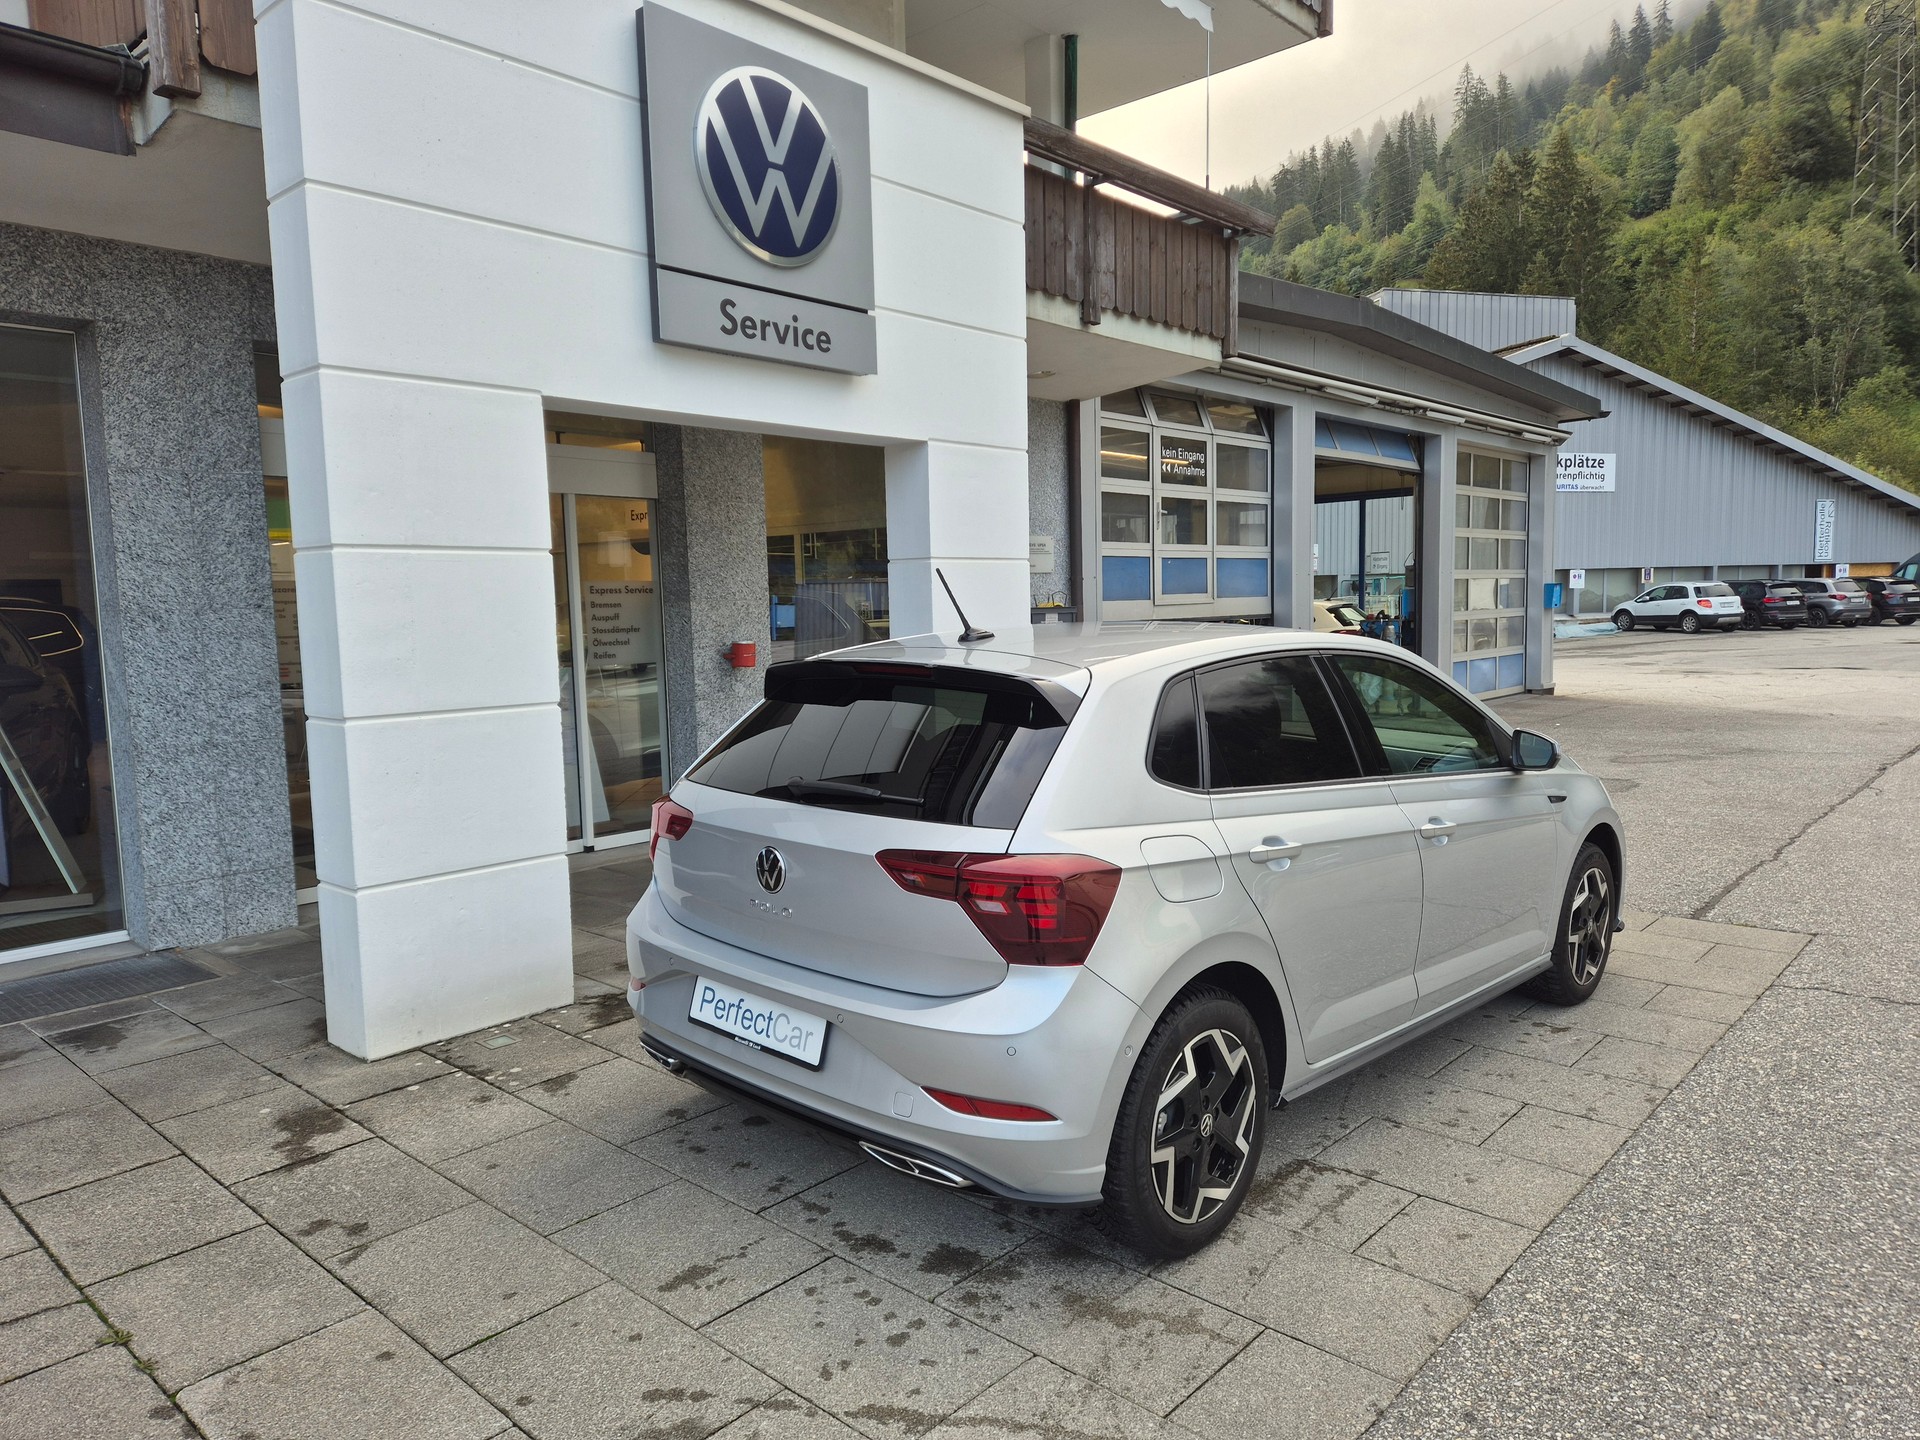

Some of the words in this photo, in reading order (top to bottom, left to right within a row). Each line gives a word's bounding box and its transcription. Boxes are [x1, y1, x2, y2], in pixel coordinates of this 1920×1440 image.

[720, 298, 832, 353] Service
[1162, 446, 1177, 458] kein
[1178, 448, 1205, 464] Eingang
[1557, 454, 1605, 471] kplätze
[1174, 463, 1206, 477] Annahme
[631, 510, 648, 523] Expr
[1817, 503, 1826, 558] Kletterhalle
[589, 586, 622, 596] Express
[624, 585, 654, 594] Service
[591, 613, 620, 622] Auspuff
[592, 625, 641, 634] Stossdämpfer
[592, 638, 630, 647] Ölwechsel
[593, 652, 617, 660] Reifen
[750, 899, 792, 918] POLO
[699, 986, 814, 1052] PerfectCar
